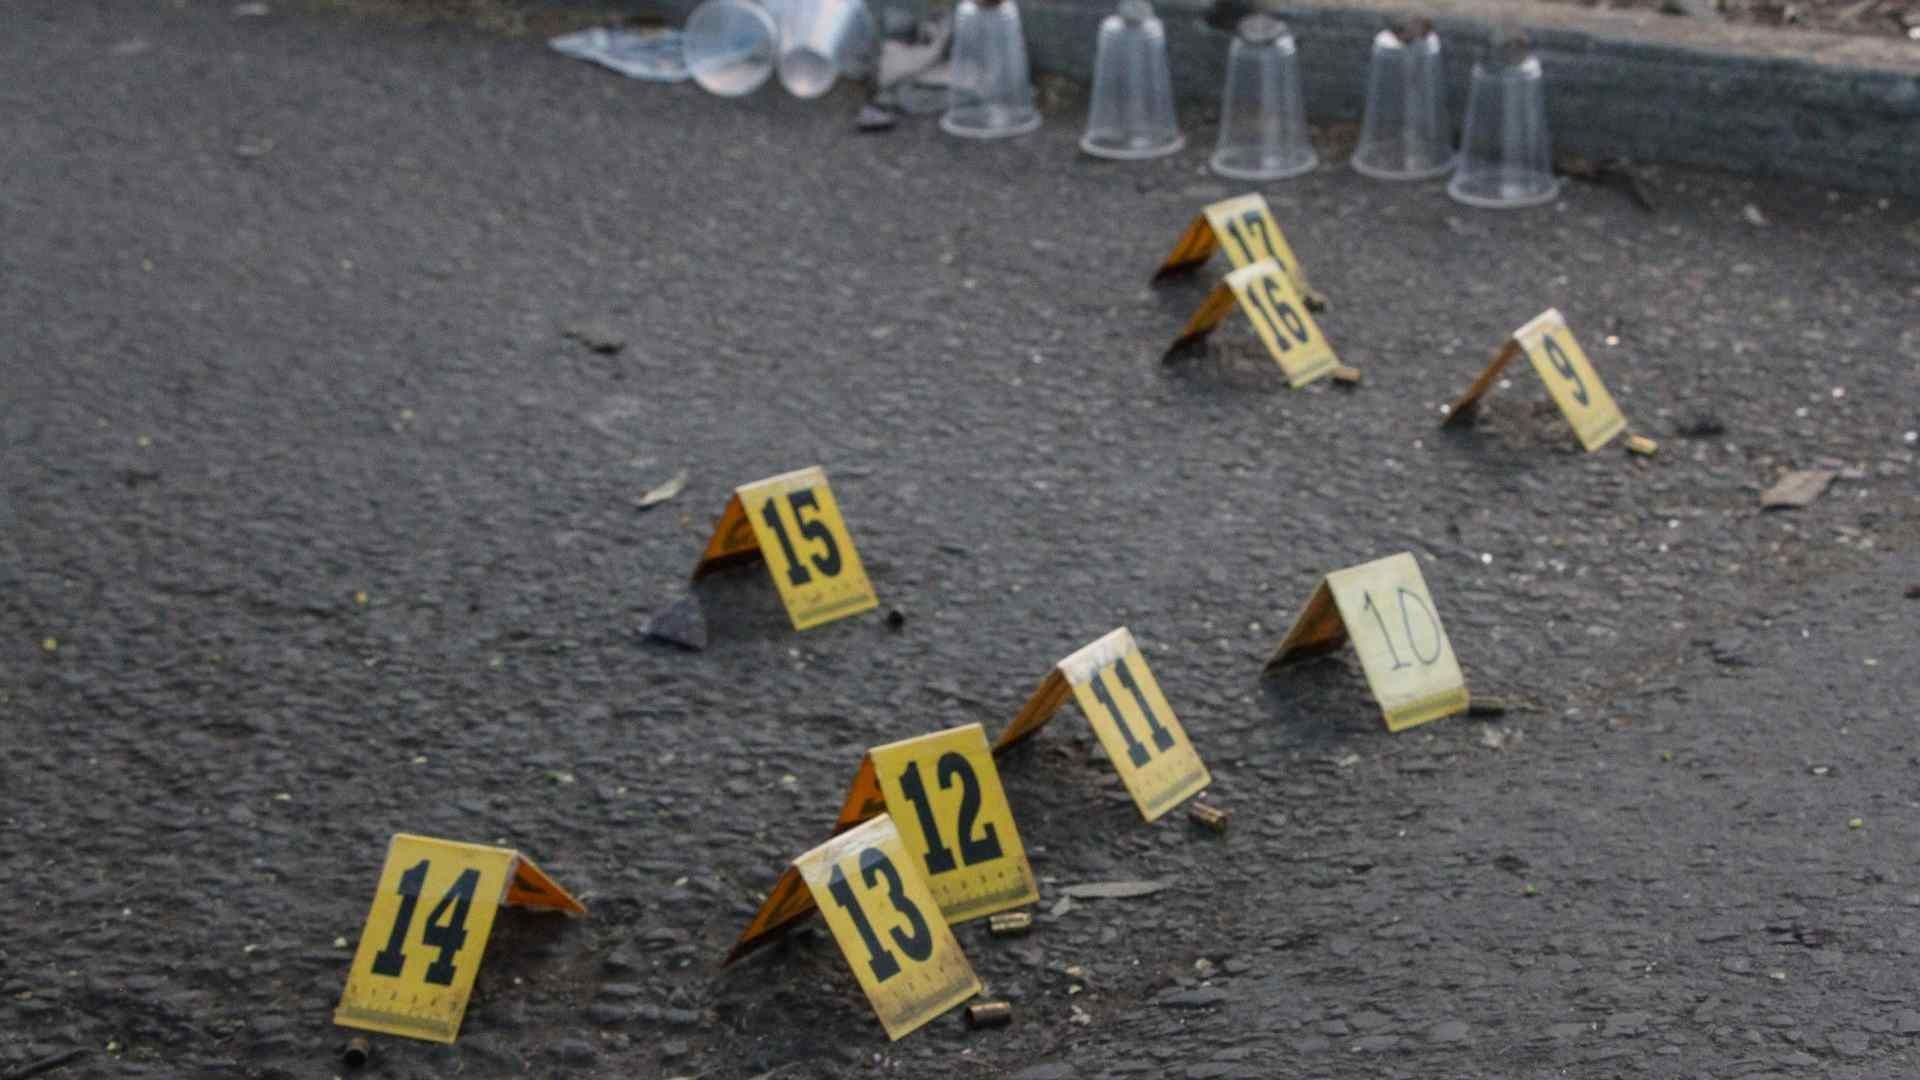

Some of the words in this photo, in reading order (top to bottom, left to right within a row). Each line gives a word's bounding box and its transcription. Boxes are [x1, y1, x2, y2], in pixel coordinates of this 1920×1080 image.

[1225, 210, 1287, 271] 17
[1247, 275, 1308, 351] 16
[1543, 333, 1590, 407] 9
[761, 488, 842, 586] 15
[1362, 586, 1443, 671] 10
[1089, 656, 1175, 768] 11
[898, 751, 1003, 876] 12
[370, 858, 481, 986] 14
[826, 846, 933, 984] 13
